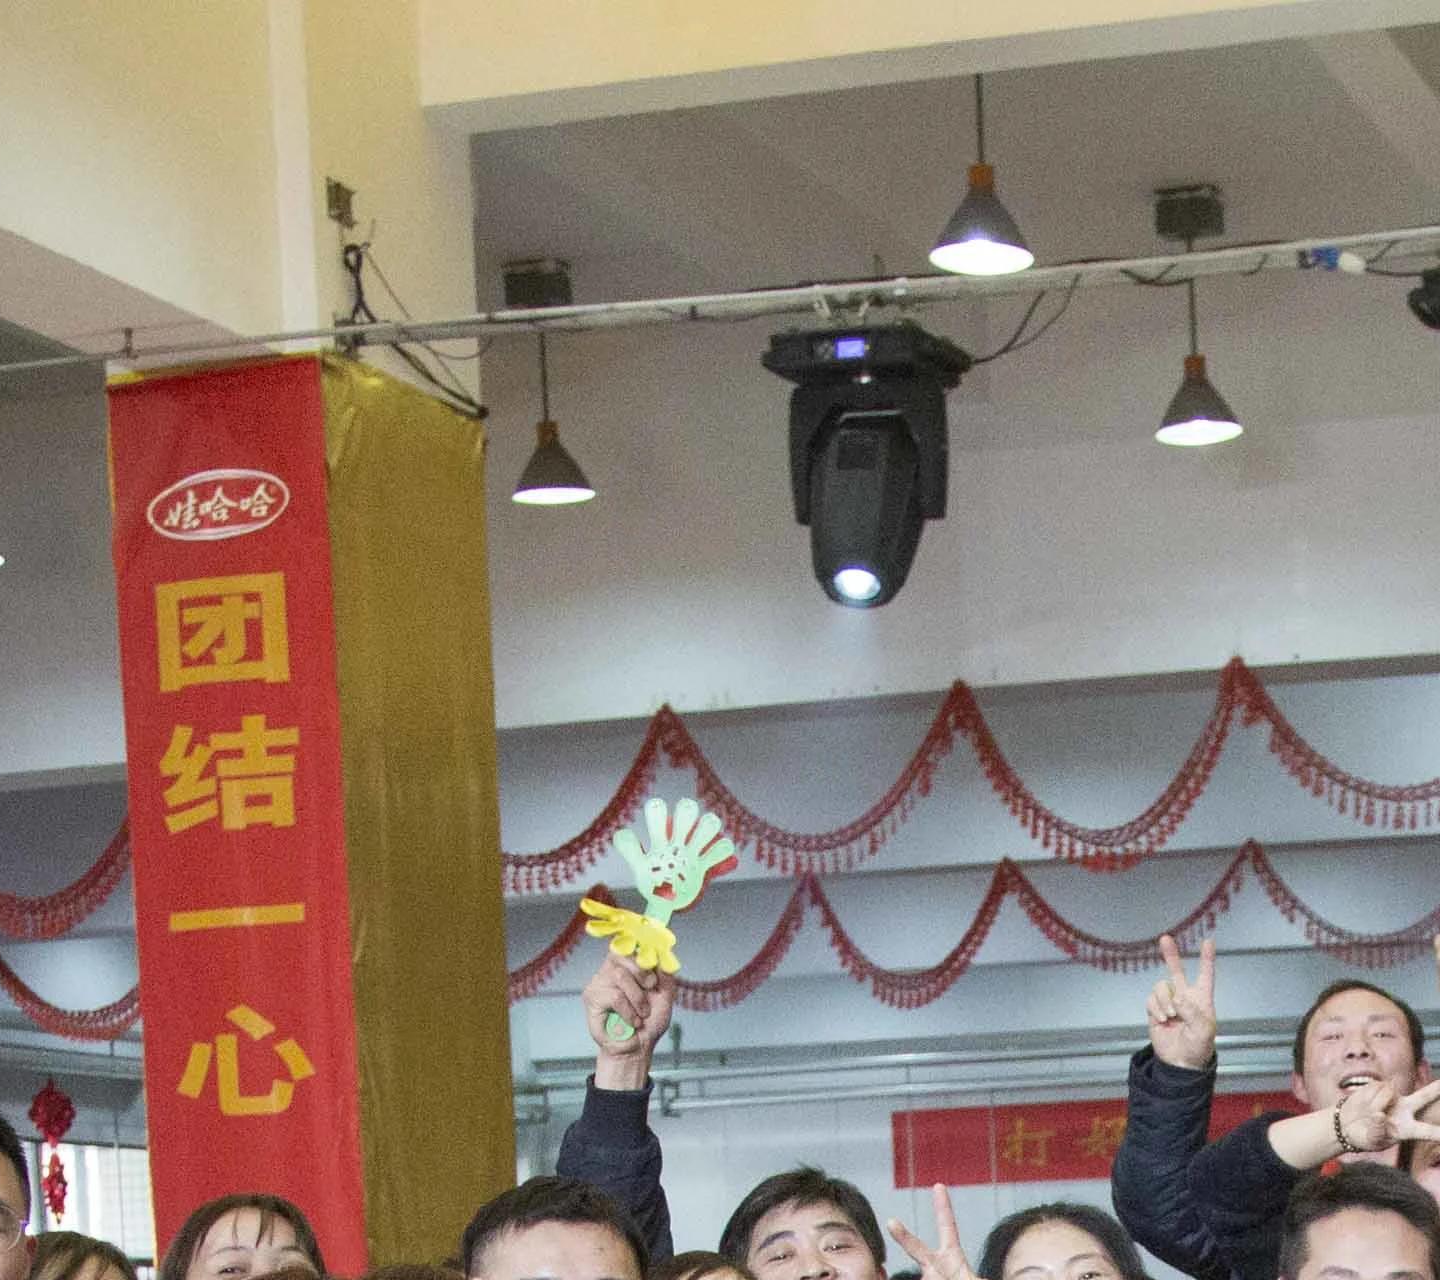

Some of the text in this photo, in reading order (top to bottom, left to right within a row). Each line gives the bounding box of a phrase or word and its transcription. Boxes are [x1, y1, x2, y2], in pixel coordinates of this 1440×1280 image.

[163, 484, 272, 530] 娃哈哈
[154, 571, 316, 1118] 团结一心
